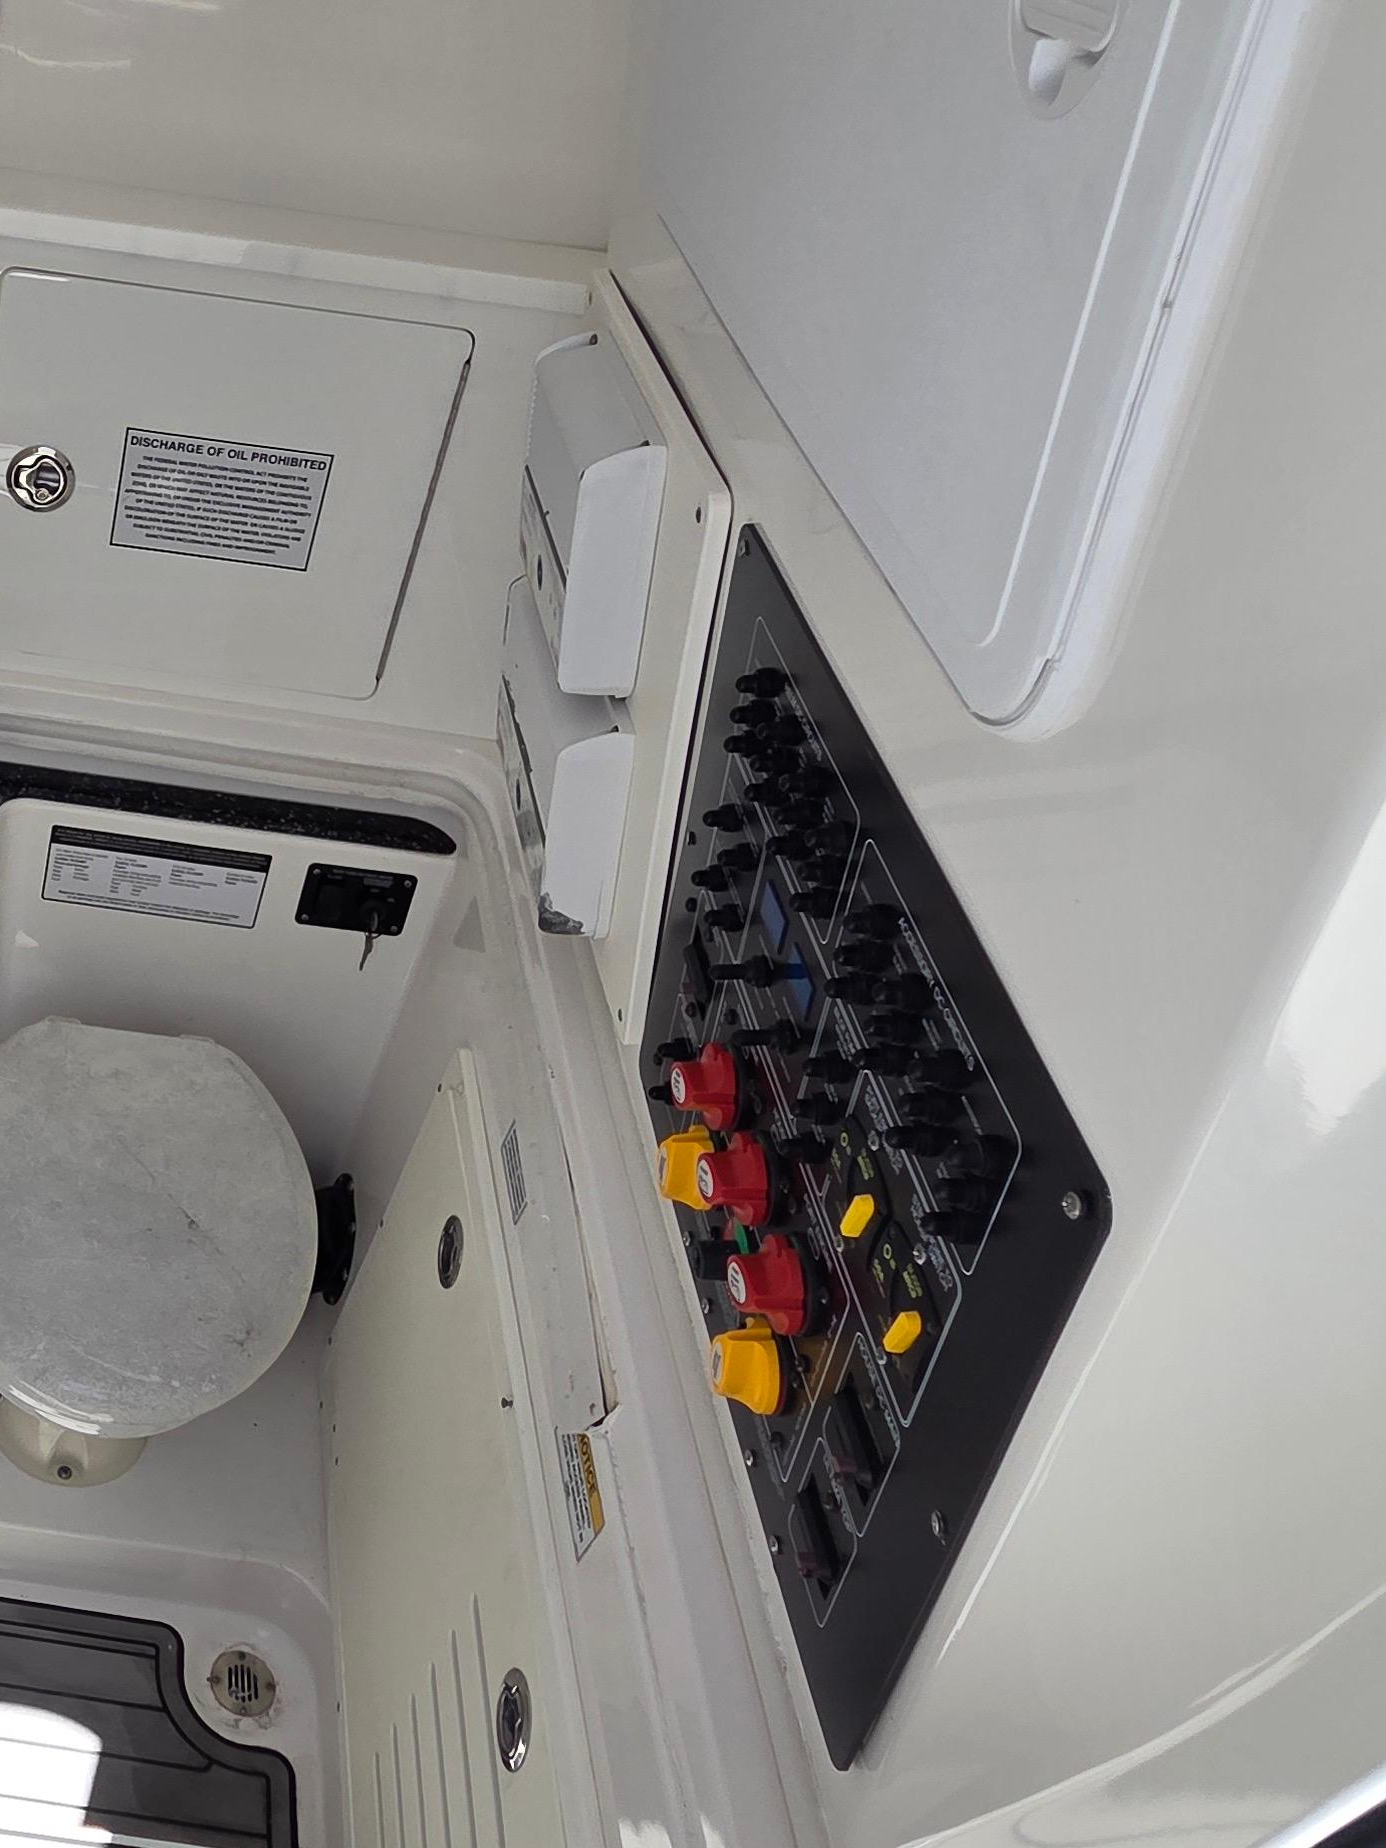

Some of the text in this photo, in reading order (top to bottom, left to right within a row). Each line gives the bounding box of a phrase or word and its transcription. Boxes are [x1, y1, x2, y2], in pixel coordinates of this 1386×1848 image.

[129, 435, 328, 471] DISCHARGE OF OIL PROHIBITED
